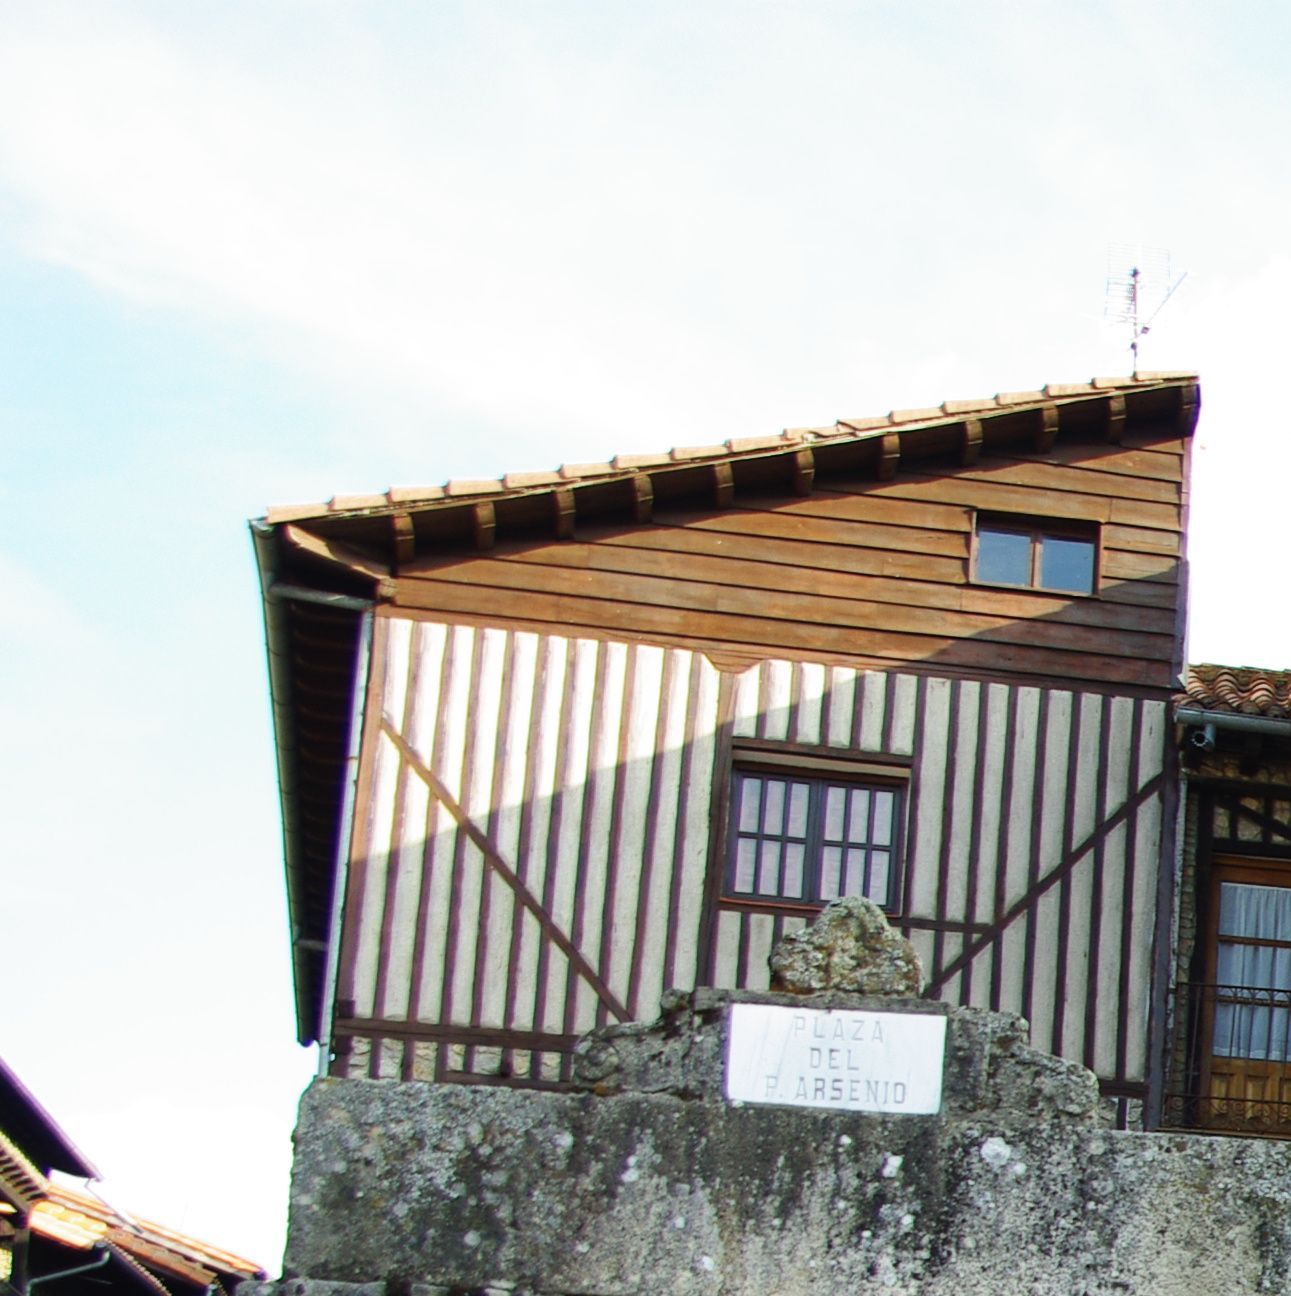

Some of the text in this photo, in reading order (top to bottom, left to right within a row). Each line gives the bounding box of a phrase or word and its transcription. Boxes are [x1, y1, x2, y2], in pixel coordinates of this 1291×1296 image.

[793, 1014, 885, 1043] PLAZA
[809, 1047, 861, 1071] DEL
[794, 1076, 907, 1105] ARSENIO
